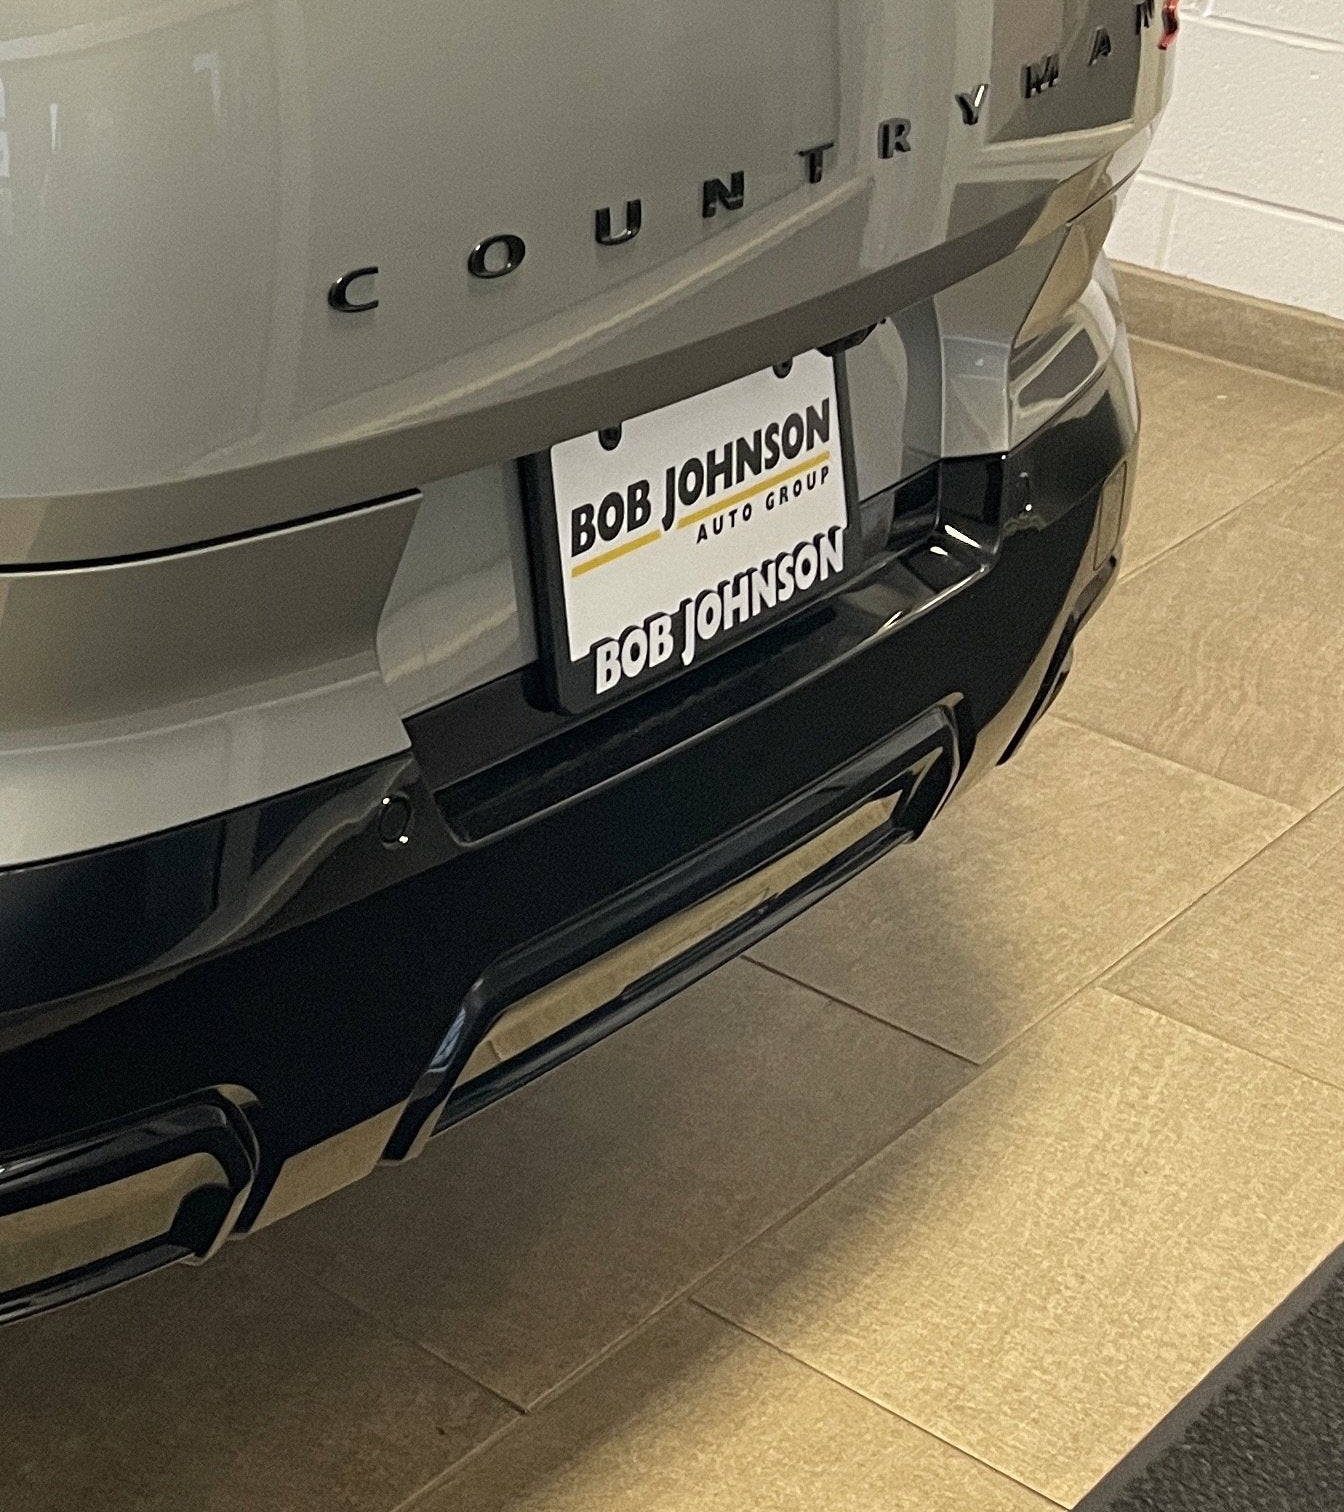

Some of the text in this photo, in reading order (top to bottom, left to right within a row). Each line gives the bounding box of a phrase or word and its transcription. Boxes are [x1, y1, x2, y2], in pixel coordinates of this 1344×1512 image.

[571, 397, 830, 557] BOB JOHNSON
[696, 465, 829, 544] AUTO GROUP
[594, 526, 844, 695] BOB JOHNSON
